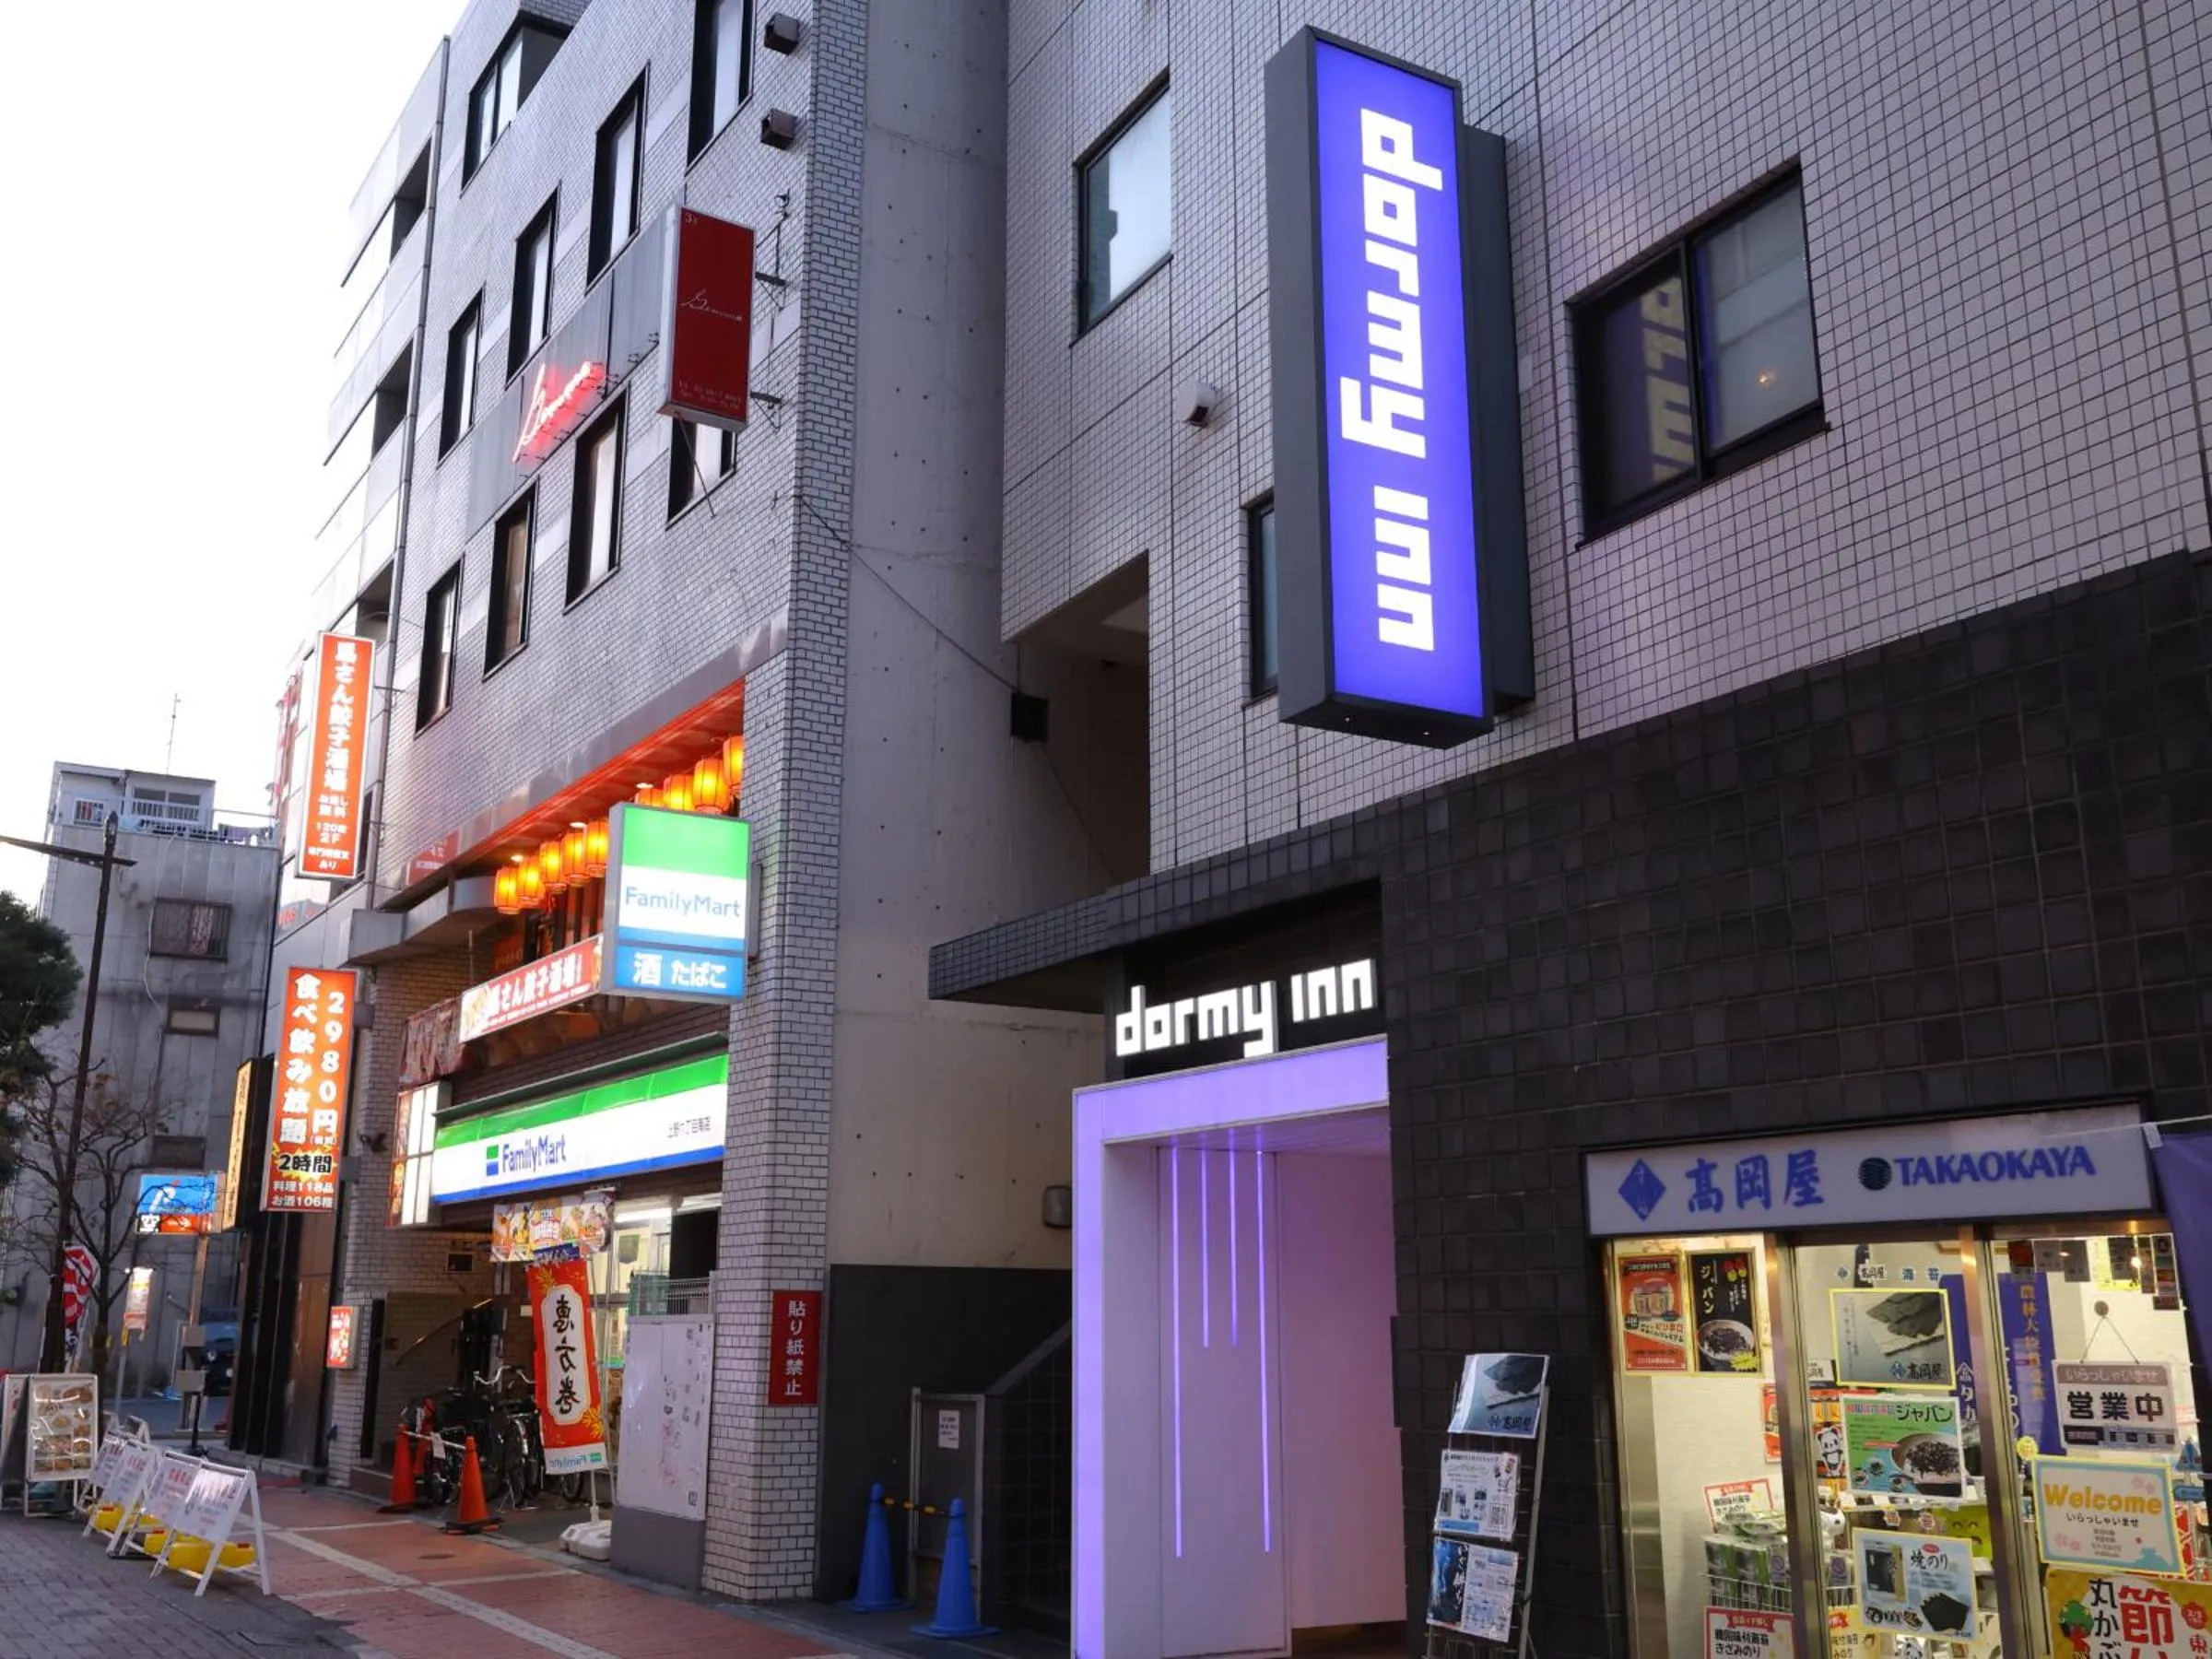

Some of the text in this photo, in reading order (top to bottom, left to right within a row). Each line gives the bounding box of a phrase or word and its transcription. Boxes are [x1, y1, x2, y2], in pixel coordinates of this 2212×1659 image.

[1339, 108, 1443, 653] dormy inn
[624, 886, 740, 918] FamilyMart
[633, 953, 727, 990] 酒 たばこ
[1115, 959, 1376, 1059] dormy inn
[279, 973, 322, 1145] 食べ飲み放題
[278, 1154, 333, 1174] 2時間
[502, 1135, 566, 1174] FamilyMart
[1894, 1145, 2097, 1187] TAKAOKAYA
[784, 1300, 807, 1396] 貼り紙禁止
[2065, 1369, 2159, 1382] いらっしゃいませ
[2067, 1391, 2164, 1422] 営業中
[2043, 1483, 2162, 1516] Welcome
[2066, 1512, 2139, 1528] いらっしゃいませ
